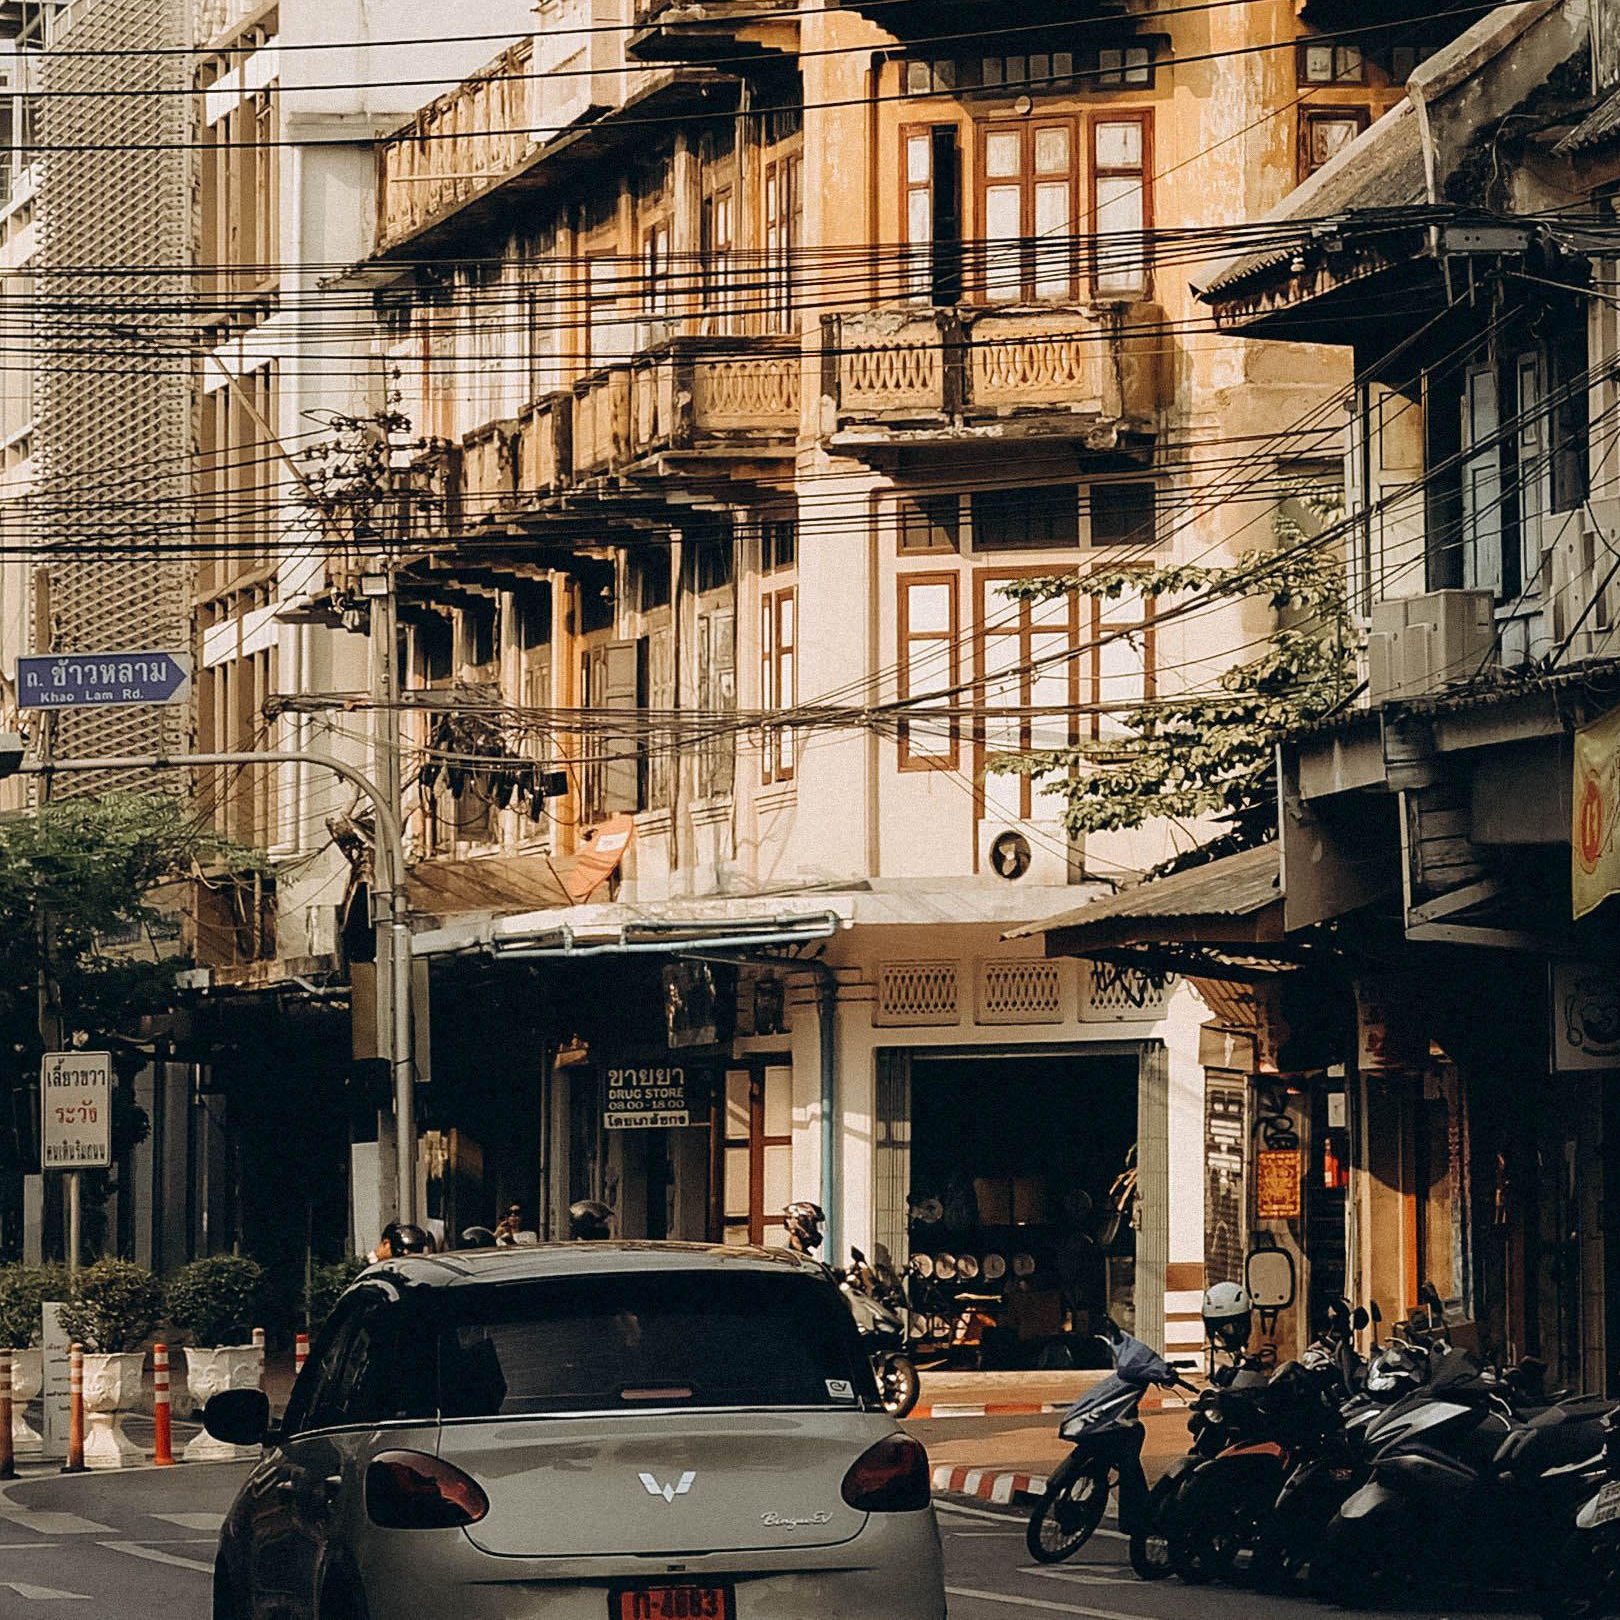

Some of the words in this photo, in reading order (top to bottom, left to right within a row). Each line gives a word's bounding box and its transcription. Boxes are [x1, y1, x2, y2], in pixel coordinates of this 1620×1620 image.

[51, 658, 167, 687] ข้าวหลาม
[40, 691, 75, 703] Khao
[85, 690, 113, 701] Lam
[122, 688, 144, 700] Rd.
[47, 1057, 106, 1087] เลี้ยวขวา
[607, 1067, 685, 1087] ขายยา
[609, 1089, 642, 1099] DRUG
[645, 1087, 684, 1099] STORE
[55, 1099, 97, 1123] ระวัง
